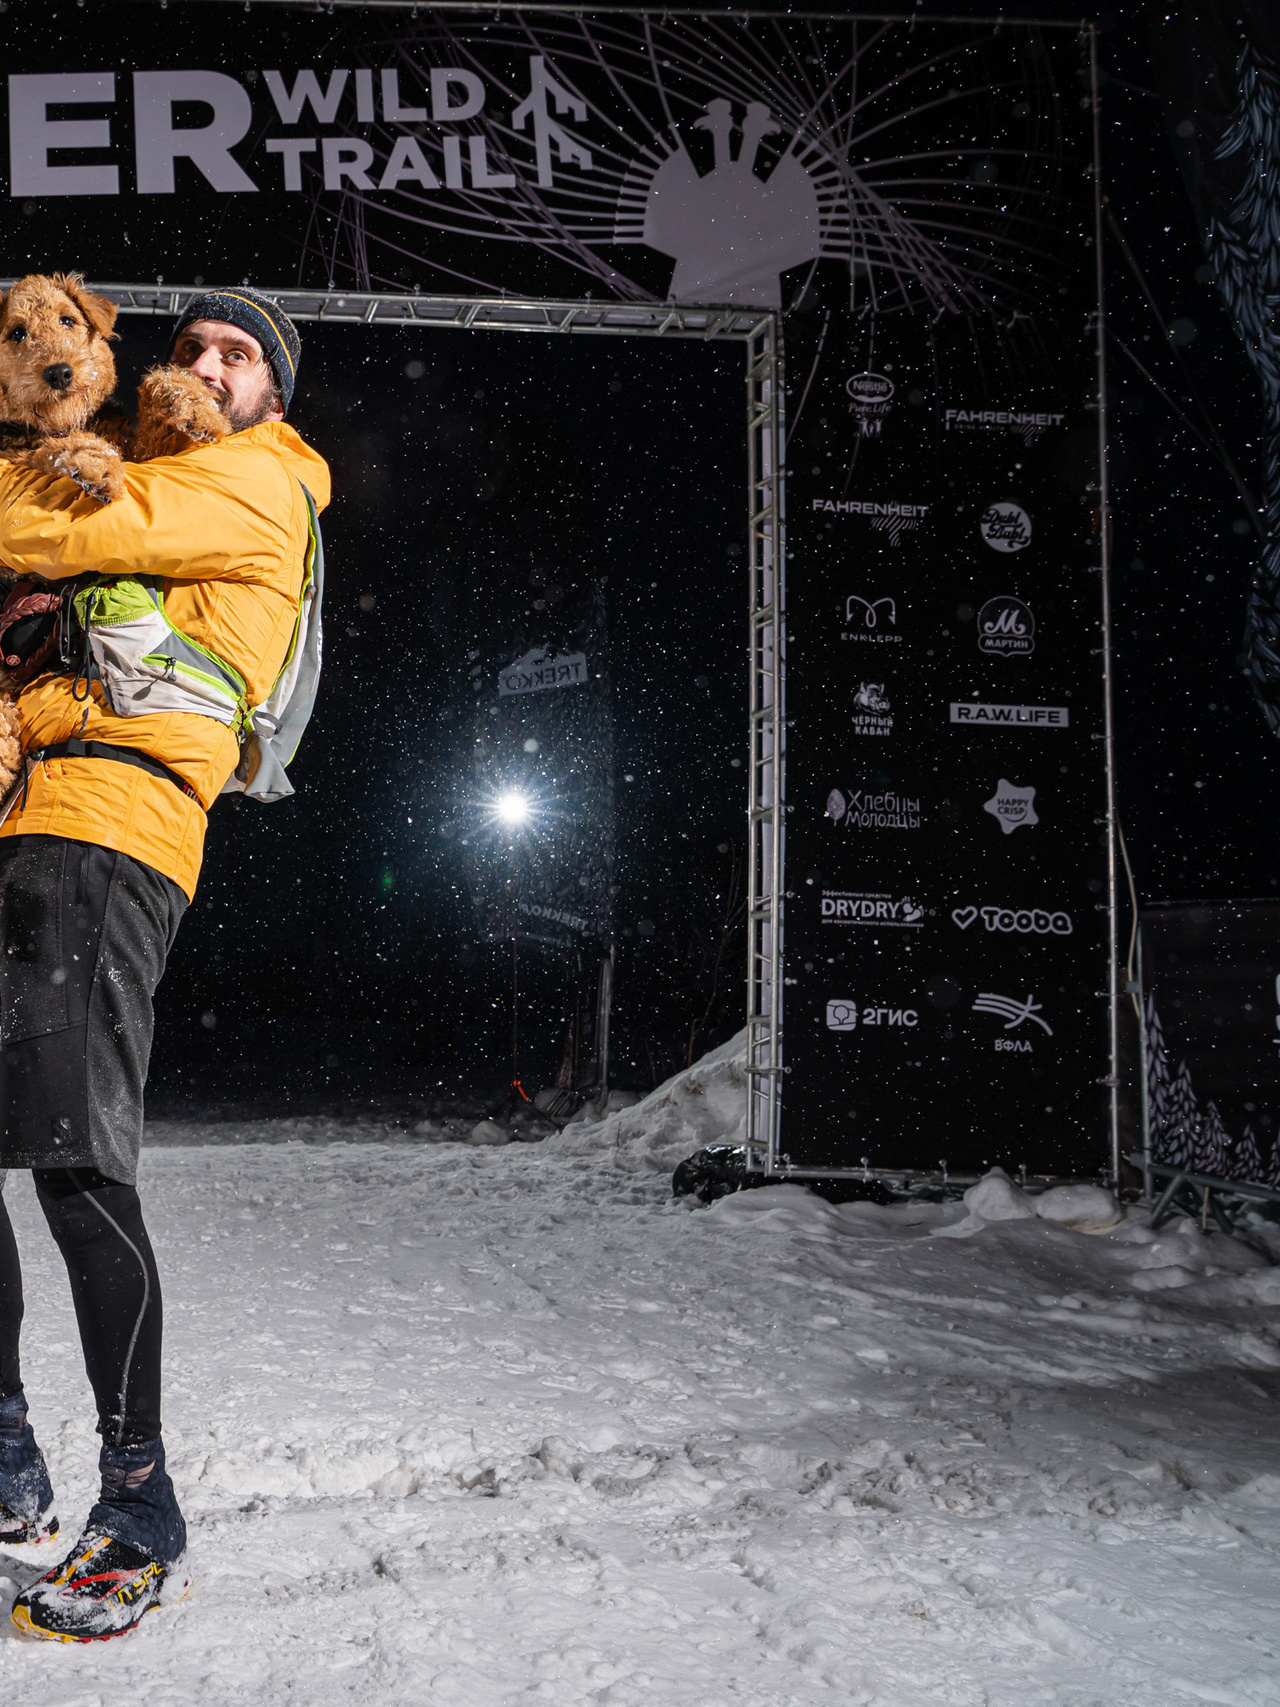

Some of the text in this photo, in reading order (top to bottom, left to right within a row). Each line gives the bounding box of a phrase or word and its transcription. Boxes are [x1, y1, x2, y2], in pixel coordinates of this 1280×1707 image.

[262, 66, 486, 125] WILD
[265, 135, 516, 192] TRAIL
[945, 409, 1065, 427] FAHRENHEIT
[813, 499, 928, 518] FAHRENHEIT
[841, 632, 903, 643] ENKLEPP
[984, 638, 1029, 650] МАРТИН
[855, 726, 890, 736] КАБАН
[847, 790, 920, 812] Хлебцы
[997, 798, 1029, 808] HAPPY
[997, 806, 1025, 815] CRISP
[821, 898, 900, 919] DRYDRY
[862, 1007, 919, 1027] 2ГИС
[994, 1039, 1033, 1053] ВФЛА
